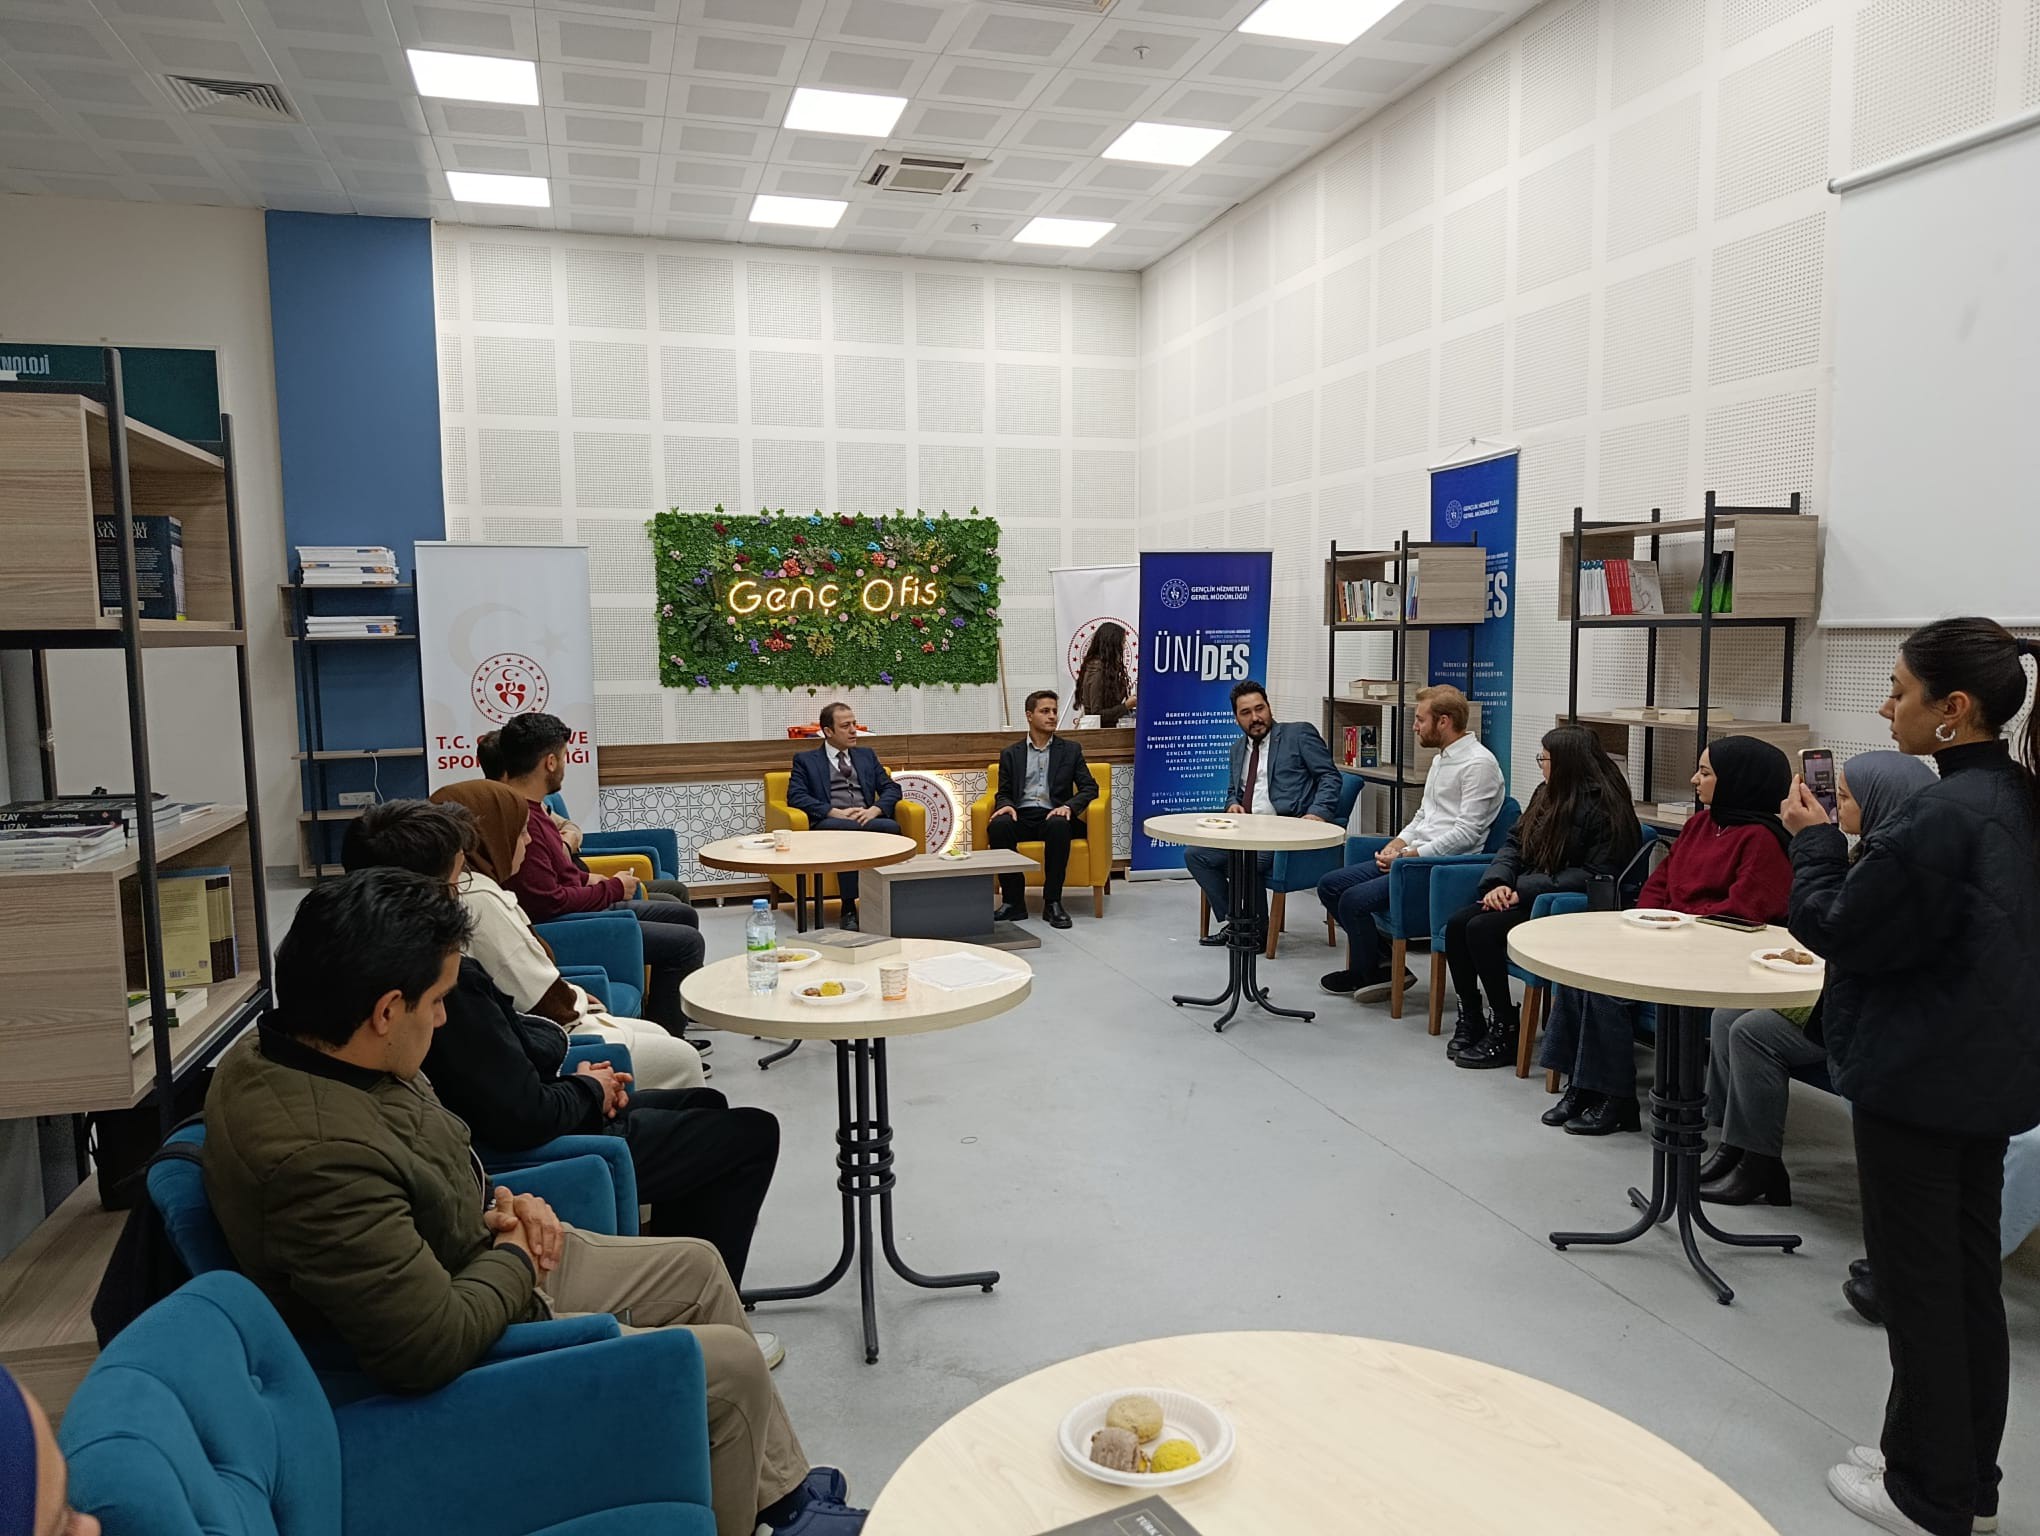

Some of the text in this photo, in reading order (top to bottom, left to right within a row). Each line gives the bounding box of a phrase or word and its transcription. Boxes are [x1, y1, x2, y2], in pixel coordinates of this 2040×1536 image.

[0, 354, 50, 375] NOLOJİ
[729, 575, 938, 616] Genç Ofis
[436, 736, 471, 750] T.C.
